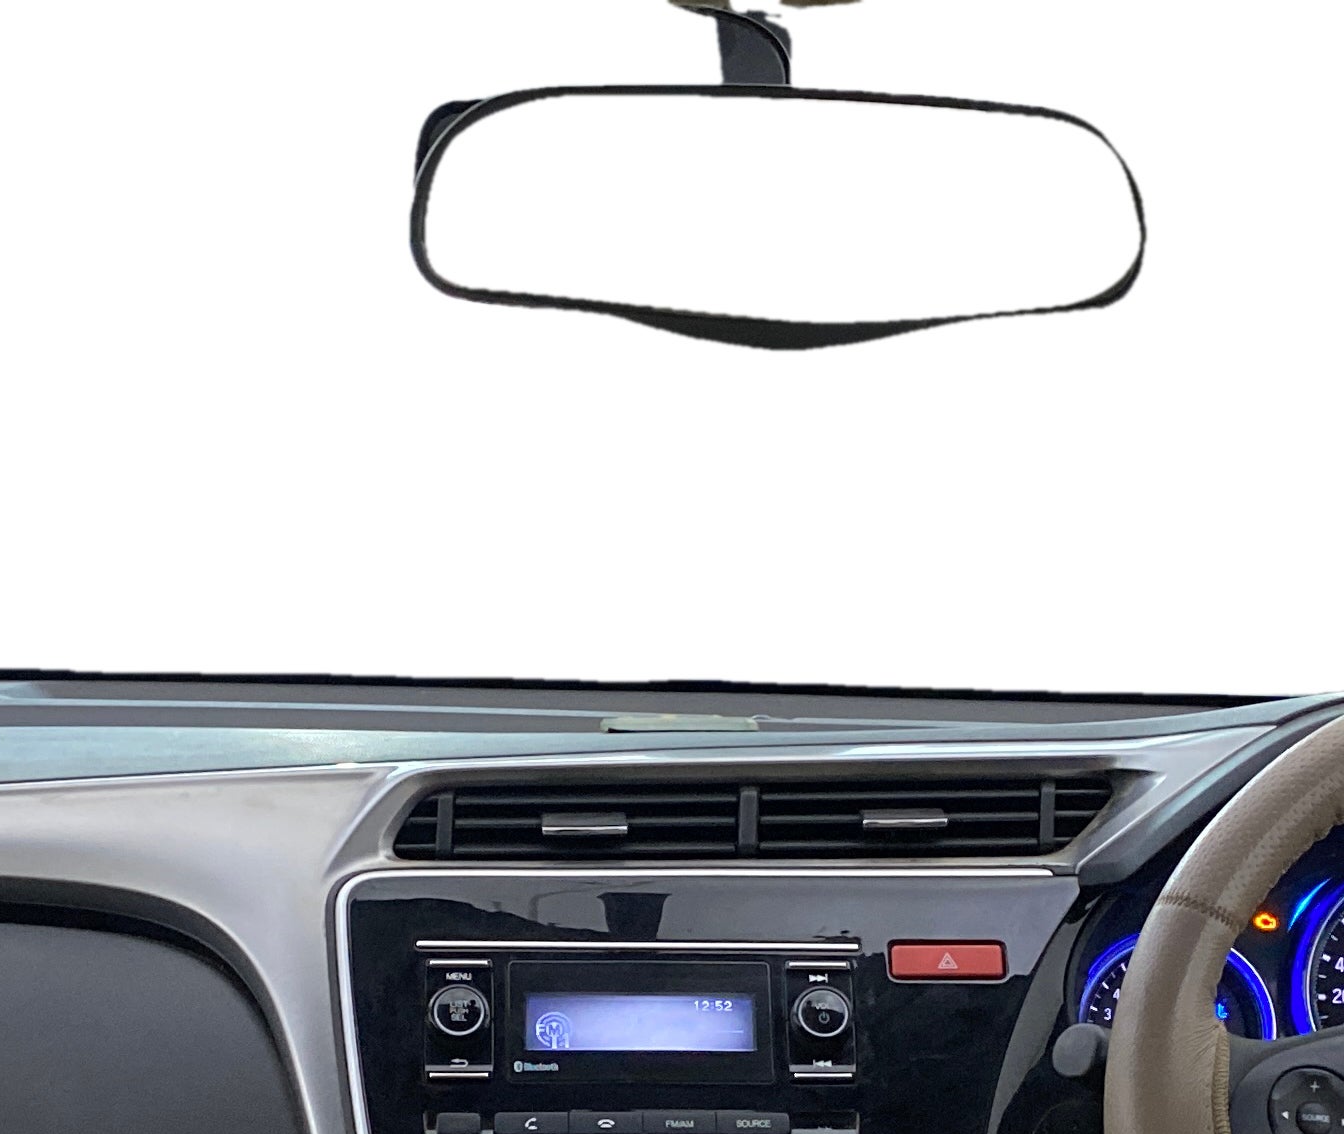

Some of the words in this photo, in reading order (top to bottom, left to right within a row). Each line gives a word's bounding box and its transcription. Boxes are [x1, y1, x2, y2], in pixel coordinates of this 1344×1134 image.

[445, 972, 473, 981] MENU
[694, 1000, 733, 1012] 12:52
[1103, 1007, 1112, 1021] 3
[736, 1119, 772, 1129] SOURCE
